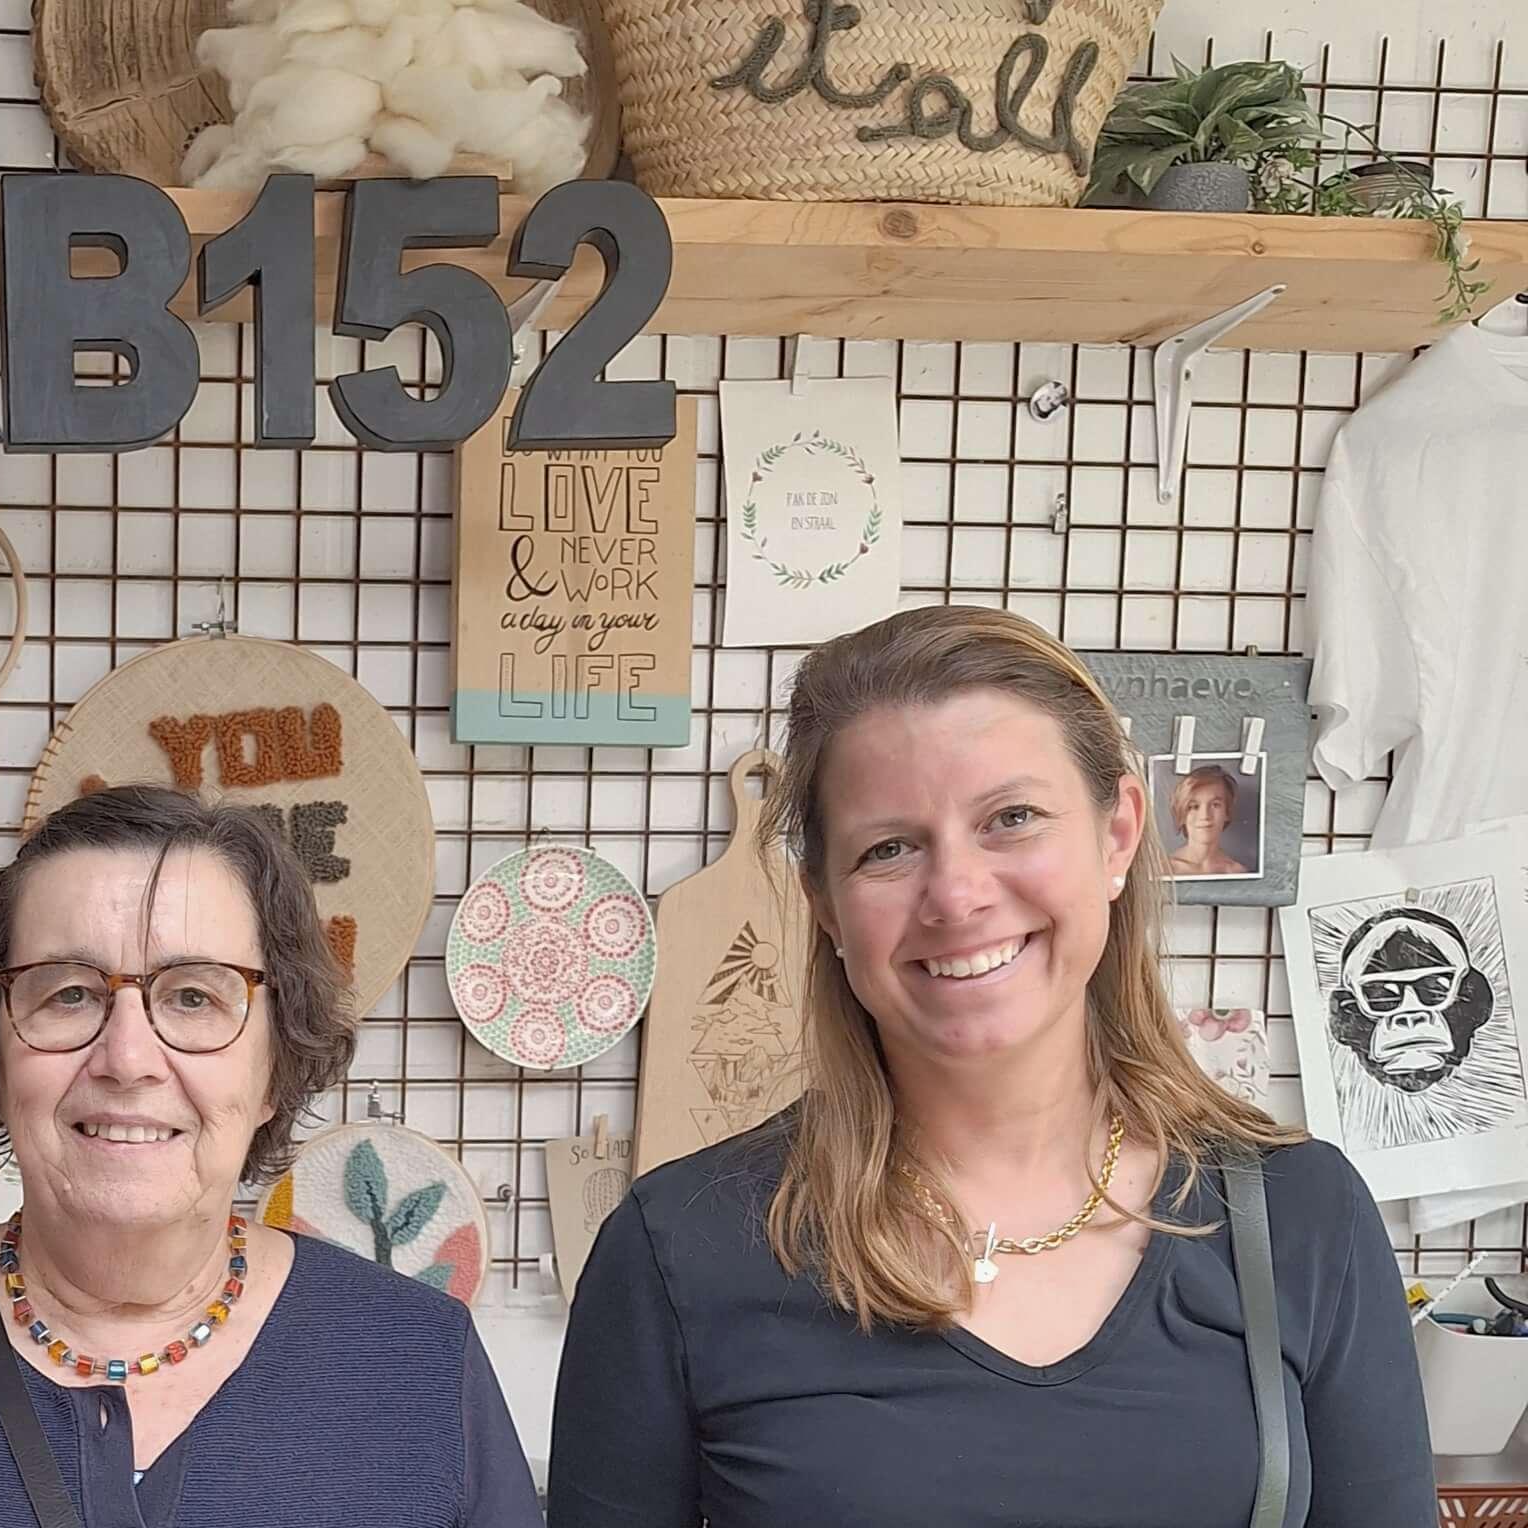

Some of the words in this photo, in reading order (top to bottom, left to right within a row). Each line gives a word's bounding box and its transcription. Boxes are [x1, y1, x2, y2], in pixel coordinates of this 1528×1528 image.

[498, 462, 660, 534] LOVE
[506, 535, 558, 602] &
[561, 537, 657, 565] NEVER
[501, 611, 518, 630] a
[520, 606, 567, 655] day
[571, 610, 595, 631] in
[587, 610, 660, 651] your
[498, 652, 657, 721] LIFE
[148, 702, 344, 789] YOU
